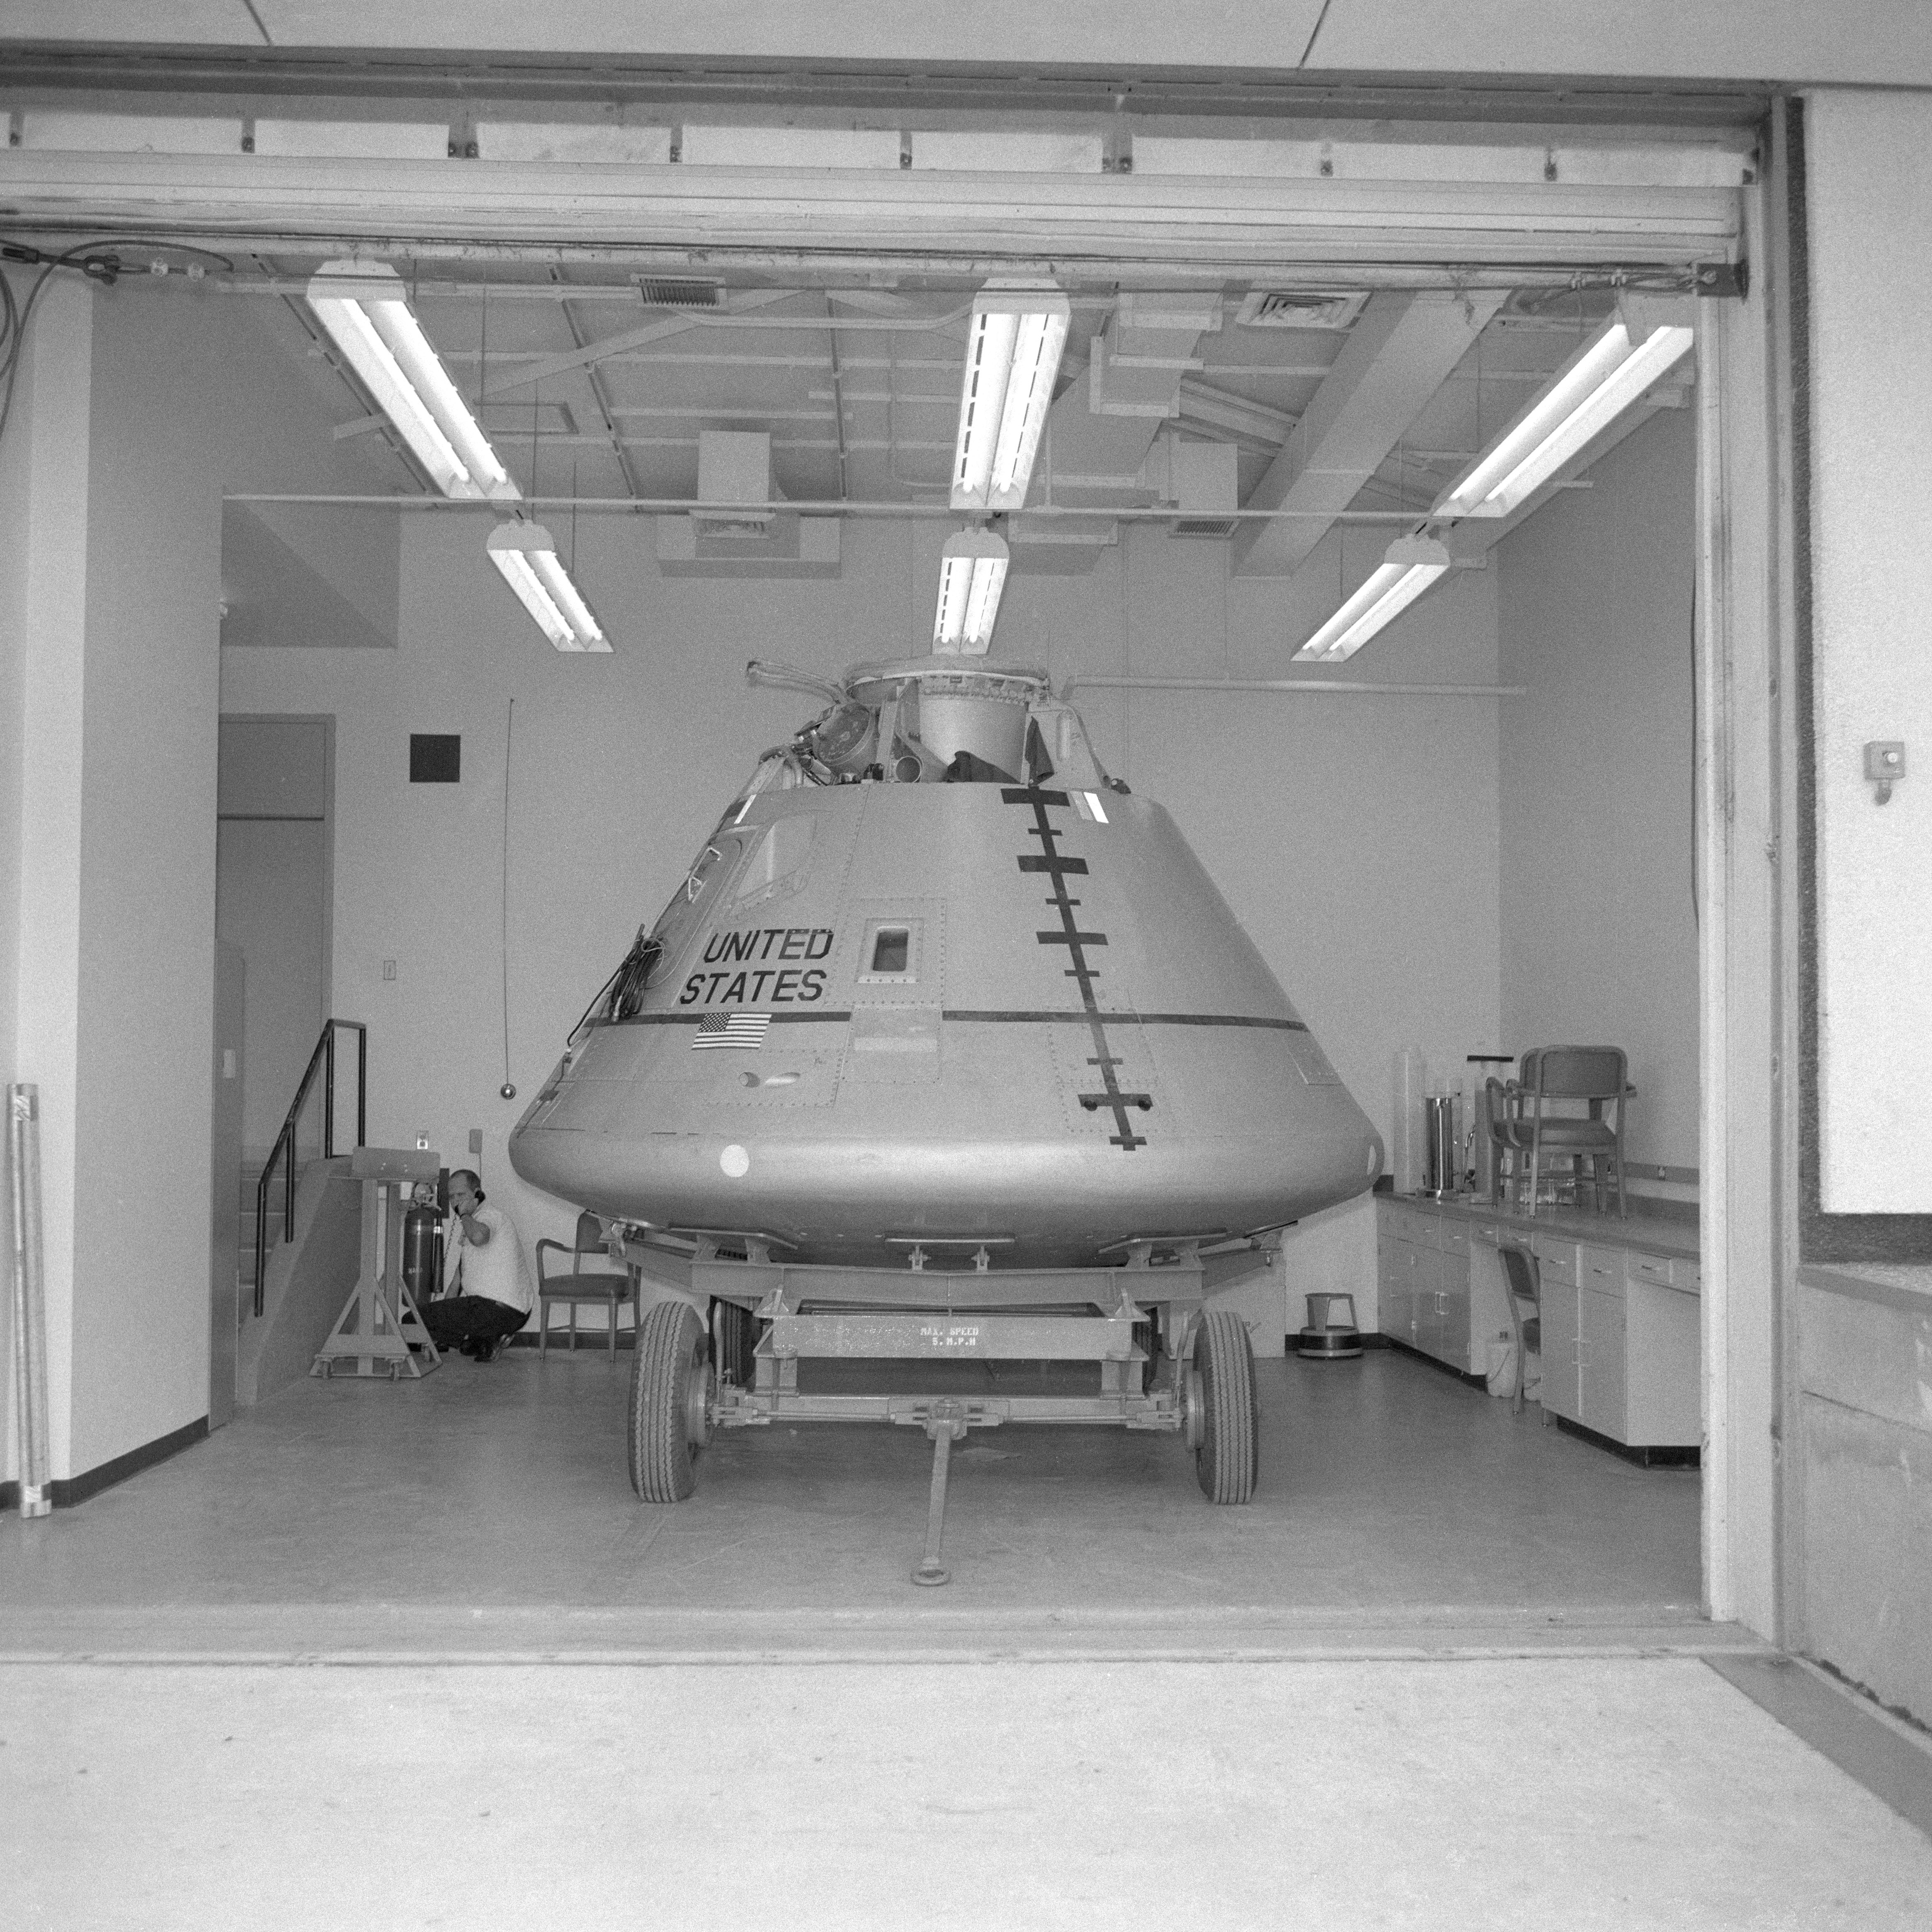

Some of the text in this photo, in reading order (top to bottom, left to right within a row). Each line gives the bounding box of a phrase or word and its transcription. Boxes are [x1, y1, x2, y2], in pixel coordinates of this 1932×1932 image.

[704, 929, 834, 963] UNITED
[680, 969, 827, 1004] STATES
[950, 1327, 979, 1336] SPEED
